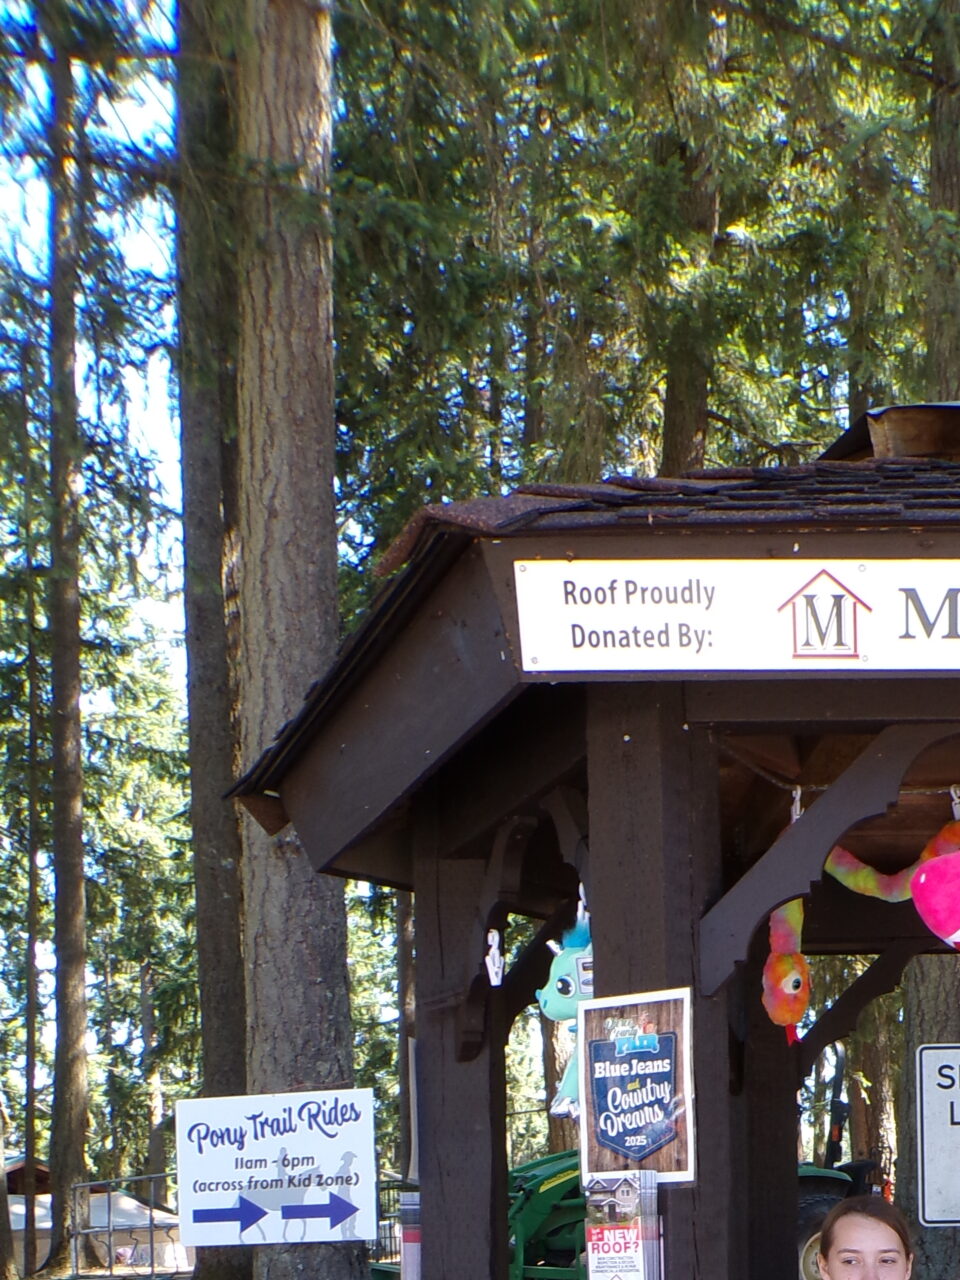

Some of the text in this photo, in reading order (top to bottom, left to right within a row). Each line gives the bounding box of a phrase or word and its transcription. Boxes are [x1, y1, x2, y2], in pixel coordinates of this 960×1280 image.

[564, 578, 716, 610] Roof Proudly
[571, 623, 713, 653] Donated By:
[594, 1058, 670, 1078] Blue Jeans
[607, 1078, 671, 1114] Country
[187, 1096, 362, 1154] Pony Trail Rides
[600, 1103, 664, 1137] Dreams
[624, 1135, 647, 1147] 2025
[234, 1157, 268, 1170] 11am
[281, 1154, 315, 1173] 6pm
[192, 1172, 360, 1193] (across from Kid Zone)
[603, 1229, 638, 1241] NEW
[591, 1241, 639, 1254] ROOF?
